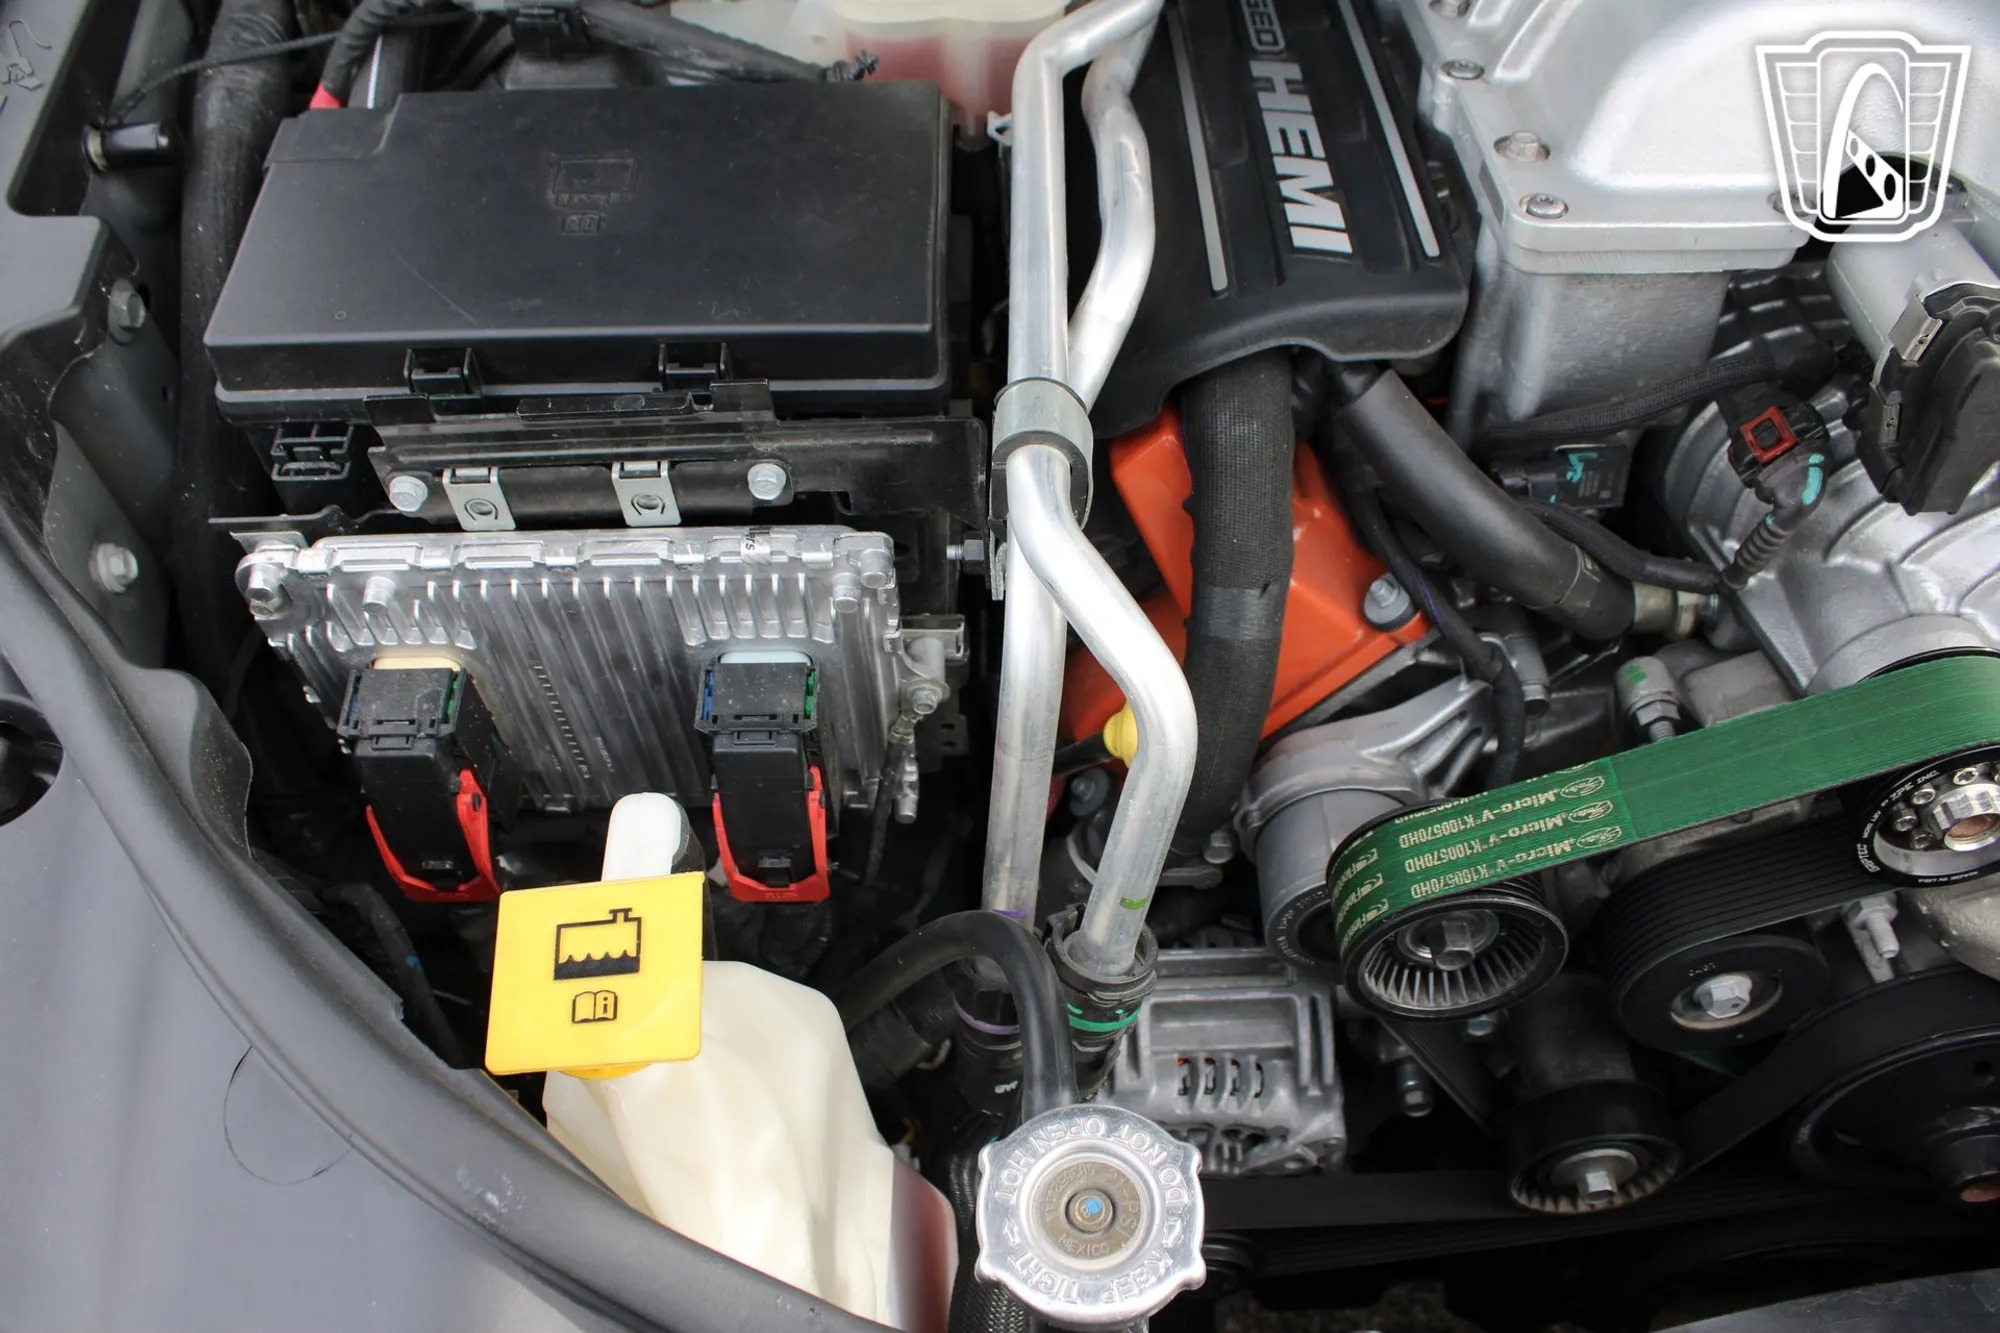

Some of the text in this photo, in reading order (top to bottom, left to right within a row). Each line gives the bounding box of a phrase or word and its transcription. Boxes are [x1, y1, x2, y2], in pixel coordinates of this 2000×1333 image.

[1249, 60, 1353, 254] HEMI
[1399, 813, 1476, 849] K100570HD
[1405, 838, 1482, 874] K100570HD
[1411, 863, 1489, 899] K100570HD
[1030, 1117, 1106, 1153] OPEN
[1109, 1124, 1168, 1168] NOT
[995, 1150, 1034, 1204] HOT
[1158, 1167, 1191, 1209] DO
[1058, 1233, 1111, 1257] MEXICO
[1006, 1251, 1174, 1305] KEEP TIGHT
